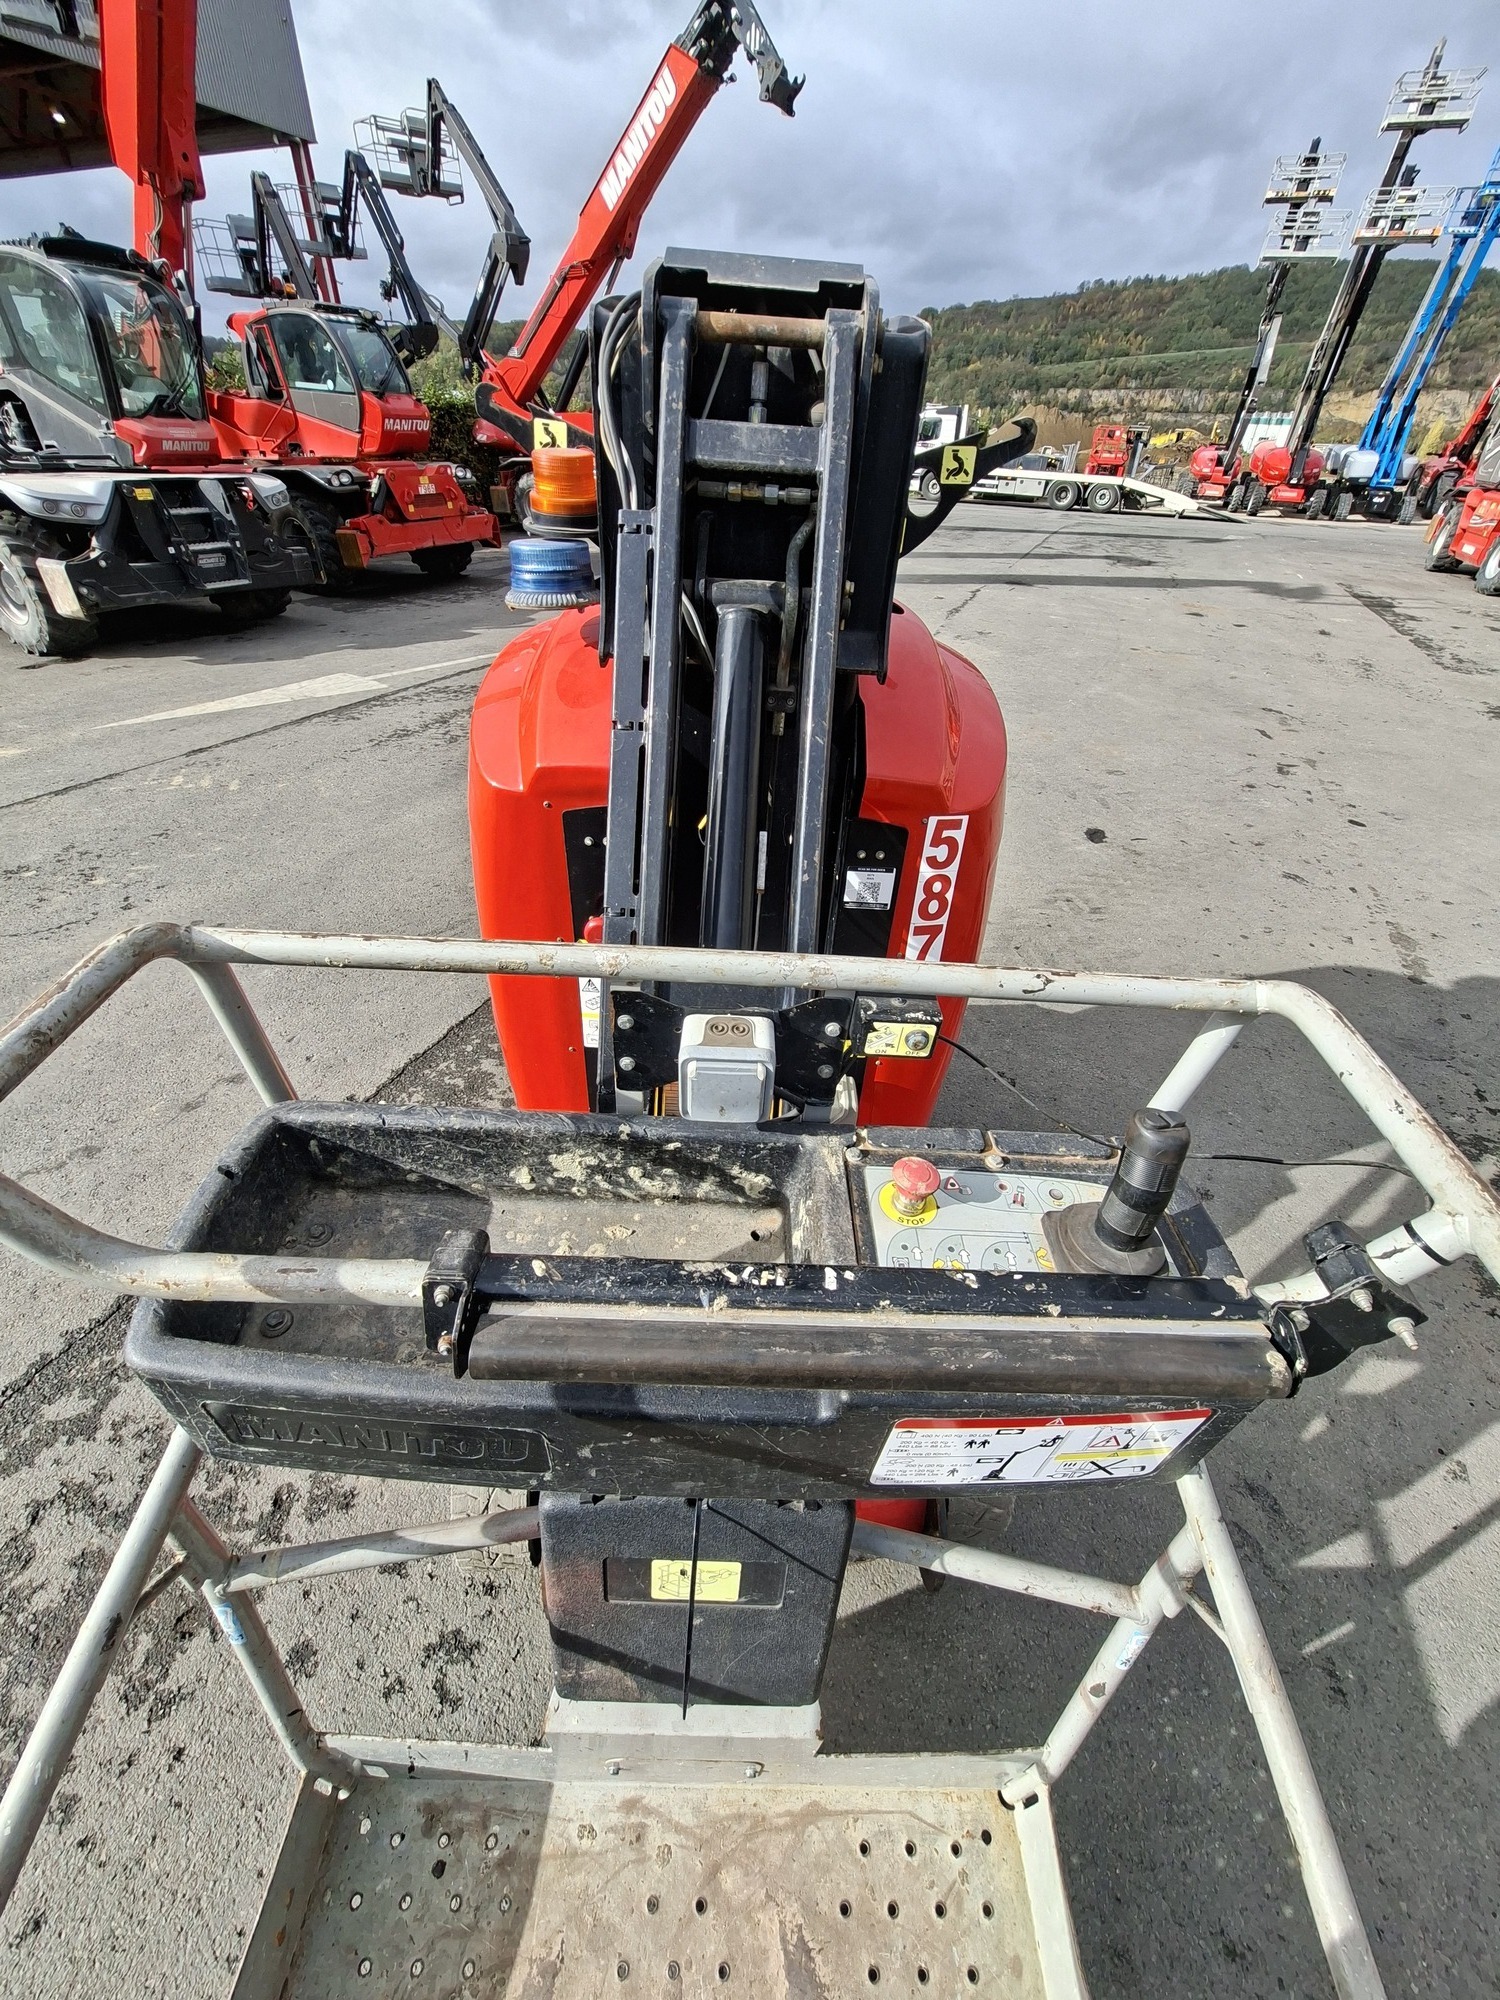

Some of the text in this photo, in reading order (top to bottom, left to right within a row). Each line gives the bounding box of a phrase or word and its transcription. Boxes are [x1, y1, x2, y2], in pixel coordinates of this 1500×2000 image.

[598, 65, 677, 212] MANITOU
[384, 418, 430, 431] MANITOU
[162, 440, 210, 452] MANITOU
[897, 1216, 926, 1226] STOP
[229, 1416, 528, 1462] MANITOU
